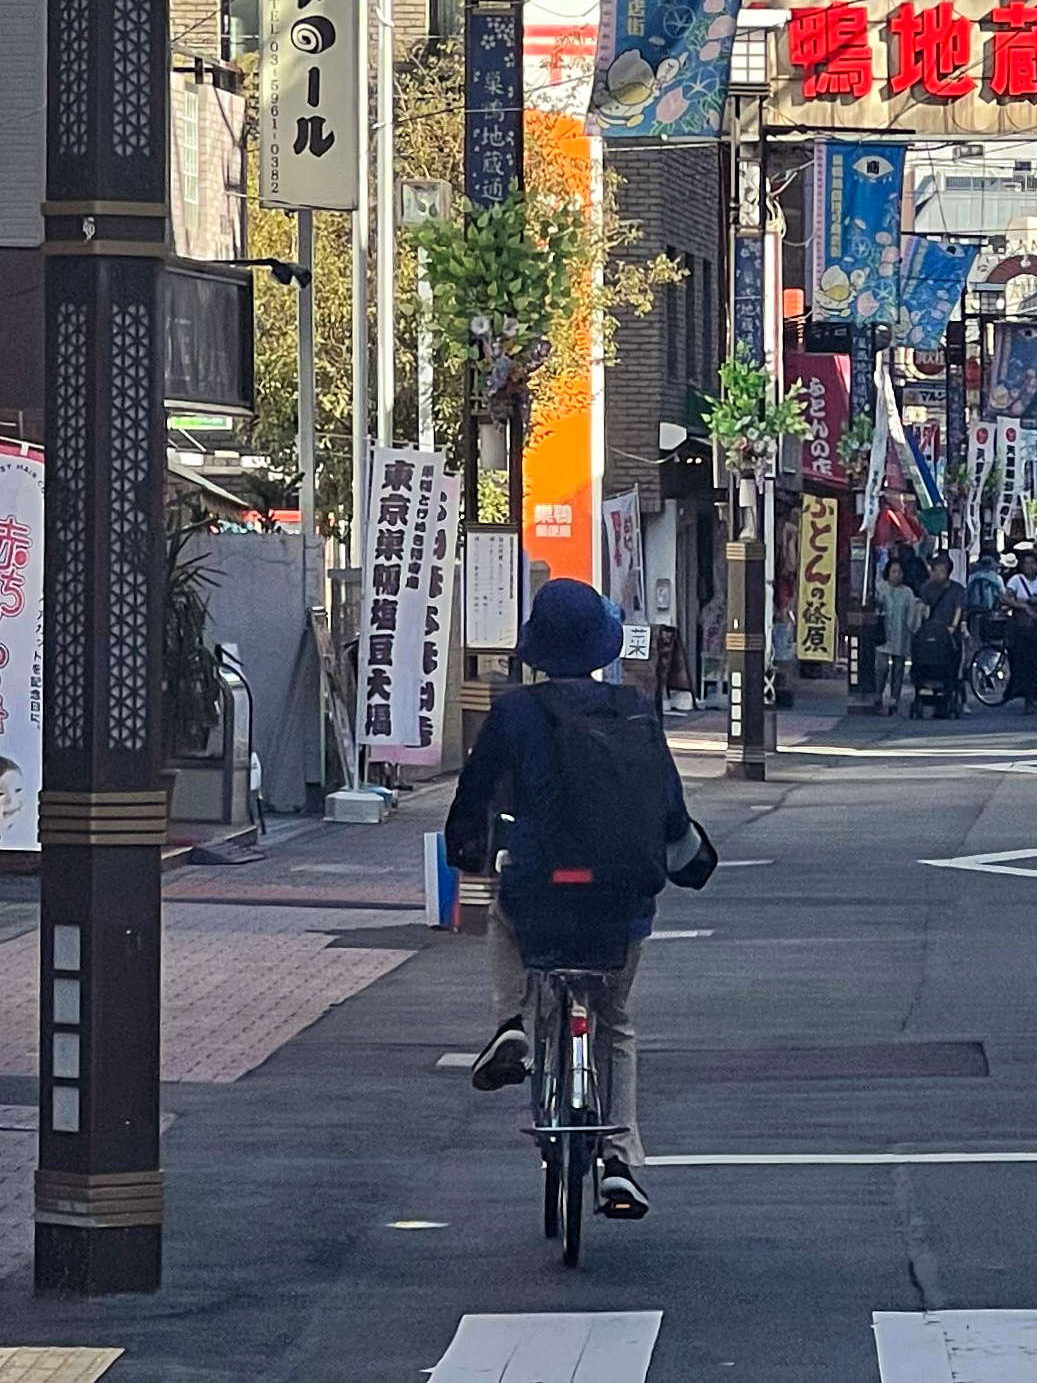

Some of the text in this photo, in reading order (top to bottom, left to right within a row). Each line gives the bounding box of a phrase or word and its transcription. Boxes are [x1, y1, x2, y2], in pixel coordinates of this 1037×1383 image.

[269, 41, 280, 193] 03-5961-0382
[365, 460, 415, 736] 東京巣鴨塩豆大福
